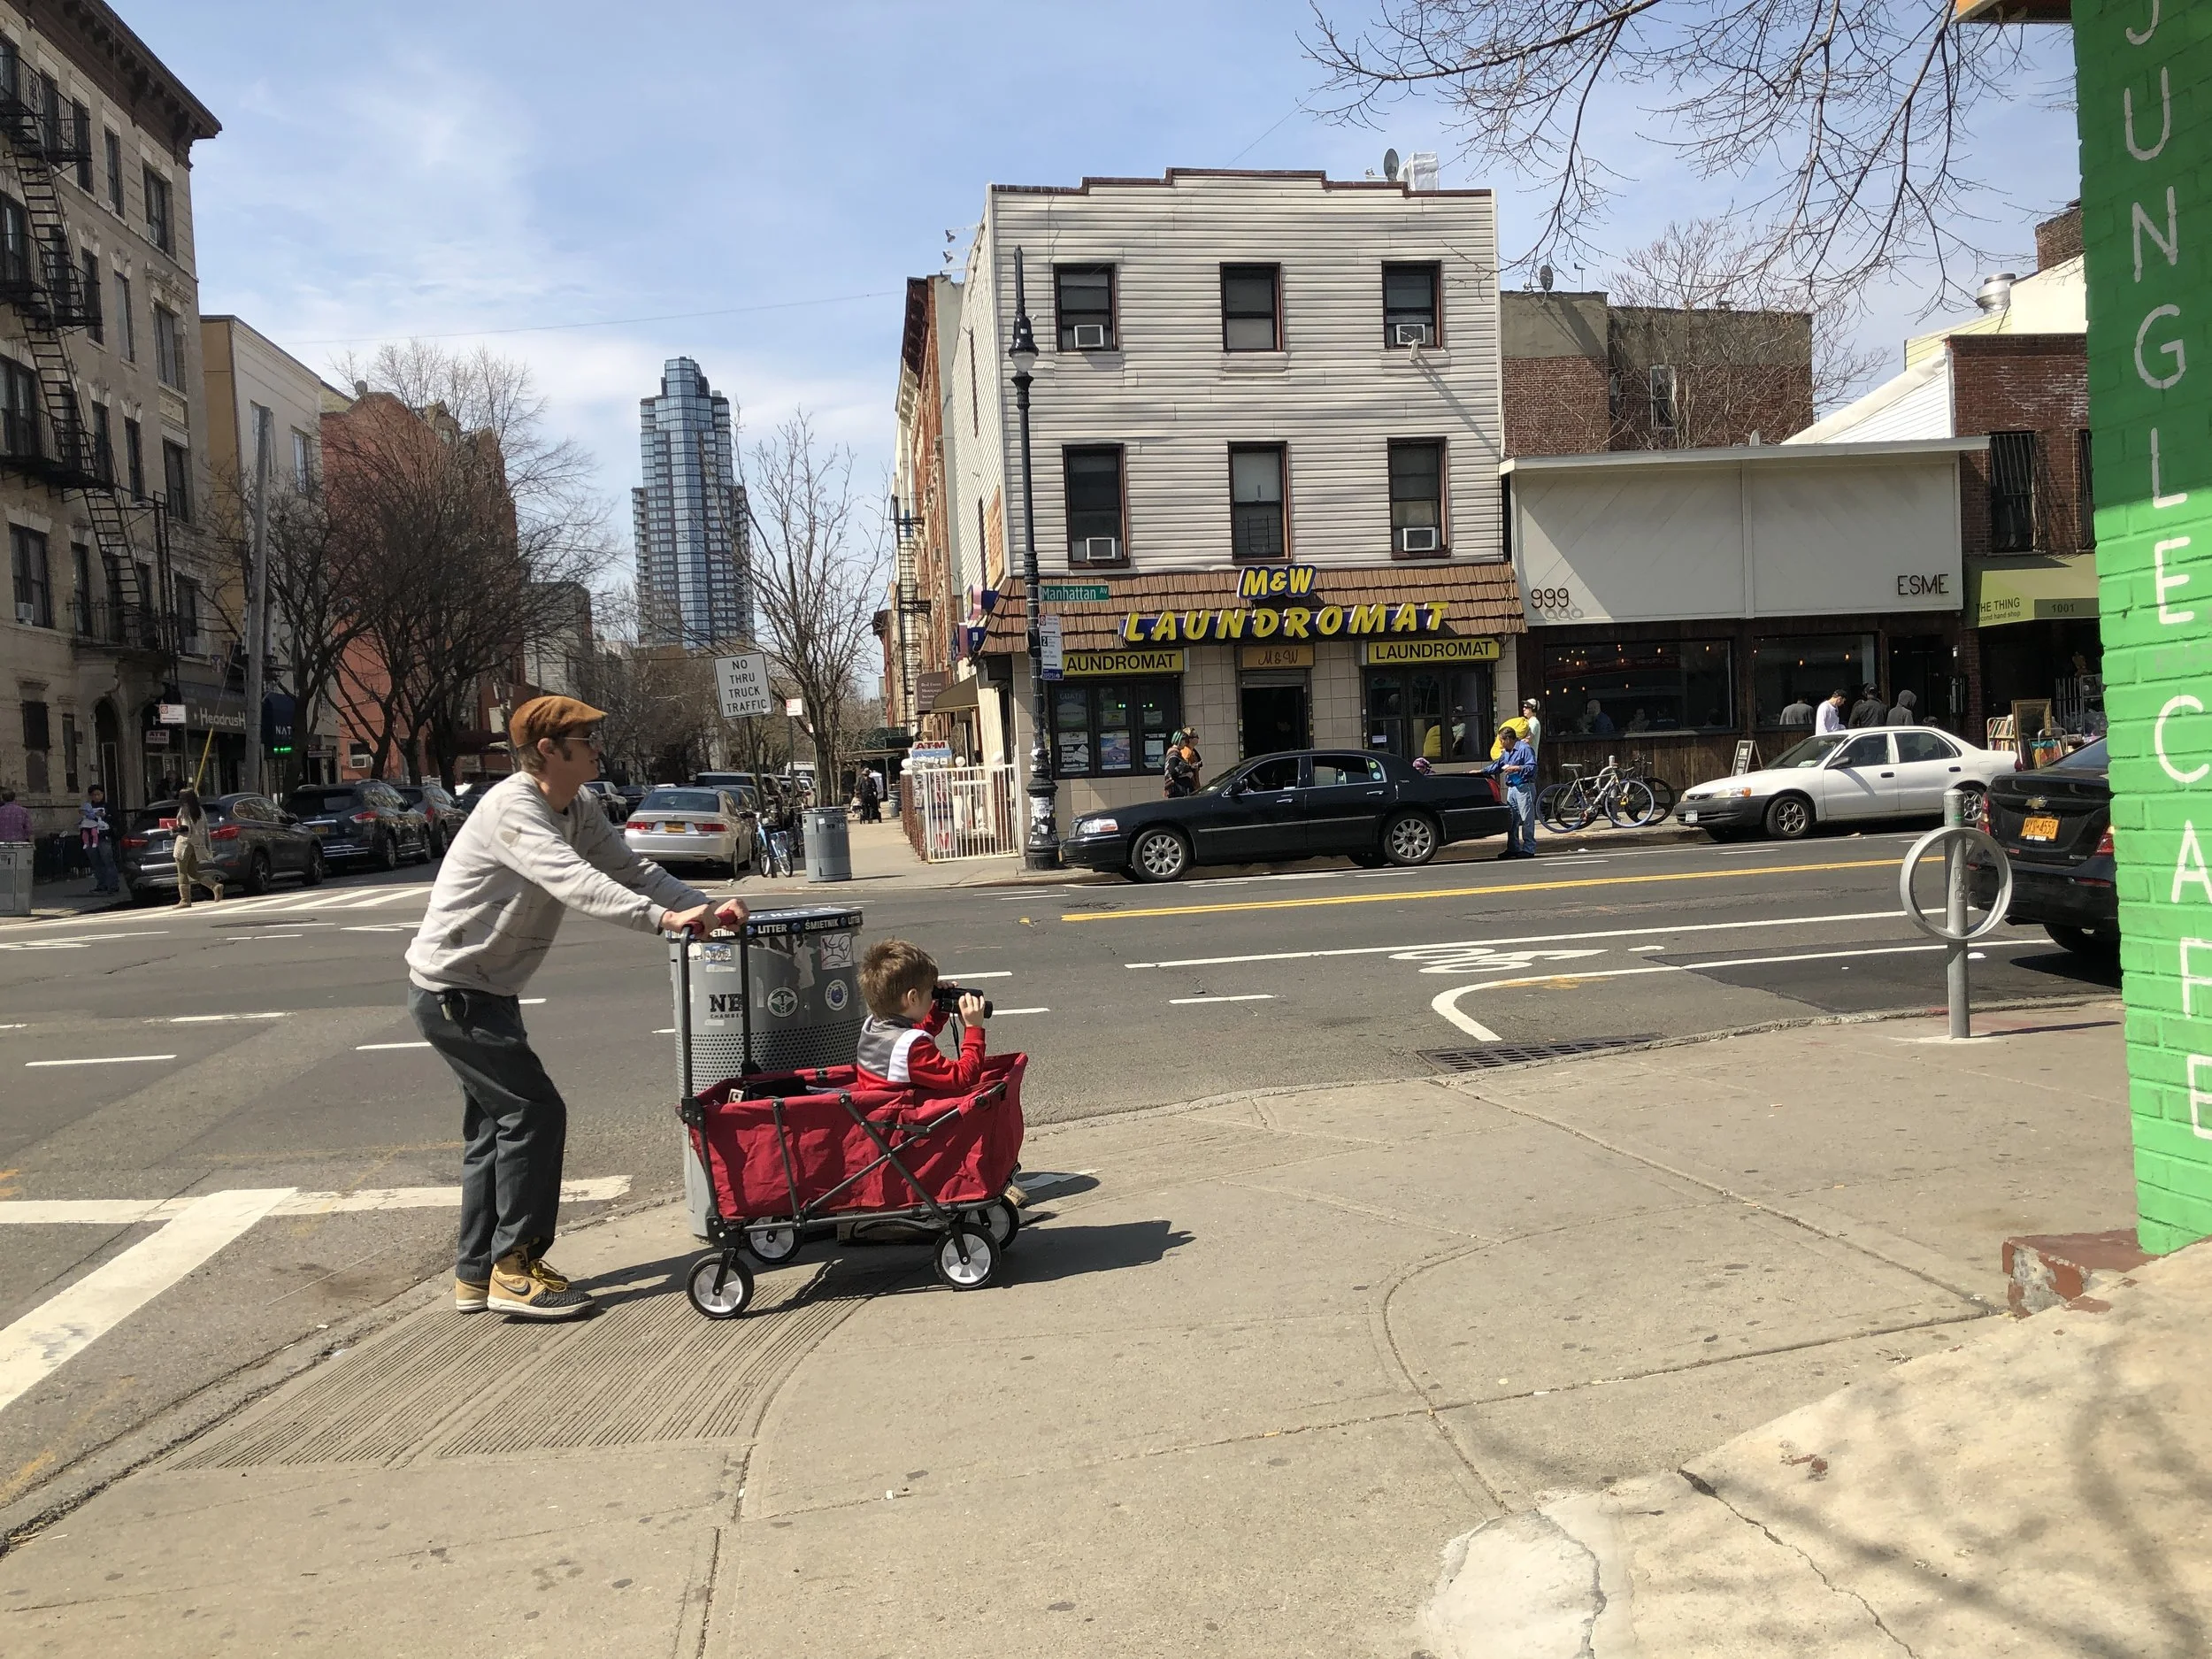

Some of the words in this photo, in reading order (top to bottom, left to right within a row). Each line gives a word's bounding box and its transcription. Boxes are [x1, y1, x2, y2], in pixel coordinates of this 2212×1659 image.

[2124, 0, 2195, 625] JUNGLE
[1240, 566, 1315, 597] M&W
[1897, 573, 1949, 595] ESME
[1041, 586, 1096, 601] Manhattan
[1099, 586, 1109, 595] Av
[1531, 588, 1570, 610] 999
[1993, 596, 2021, 611] THING
[2051, 603, 2075, 613] 1001
[1123, 602, 1450, 642] LAUNDROMAT
[1993, 611, 2007, 620] hand
[1257, 649, 1299, 665] M&W
[1375, 641, 1493, 660] LAUNDROMAT
[732, 658, 749, 671] NO
[1063, 653, 1177, 672] AUNDROMAT
[729, 672, 756, 685] THRU
[728, 686, 761, 699] TRUCK
[726, 698, 768, 713] TRAFFIC
[915, 741, 946, 750] ATM
[2154, 694, 2212, 1141] CAFE
[757, 923, 787, 934] LITTER
[804, 918, 840, 931] ŚMIETNIK
